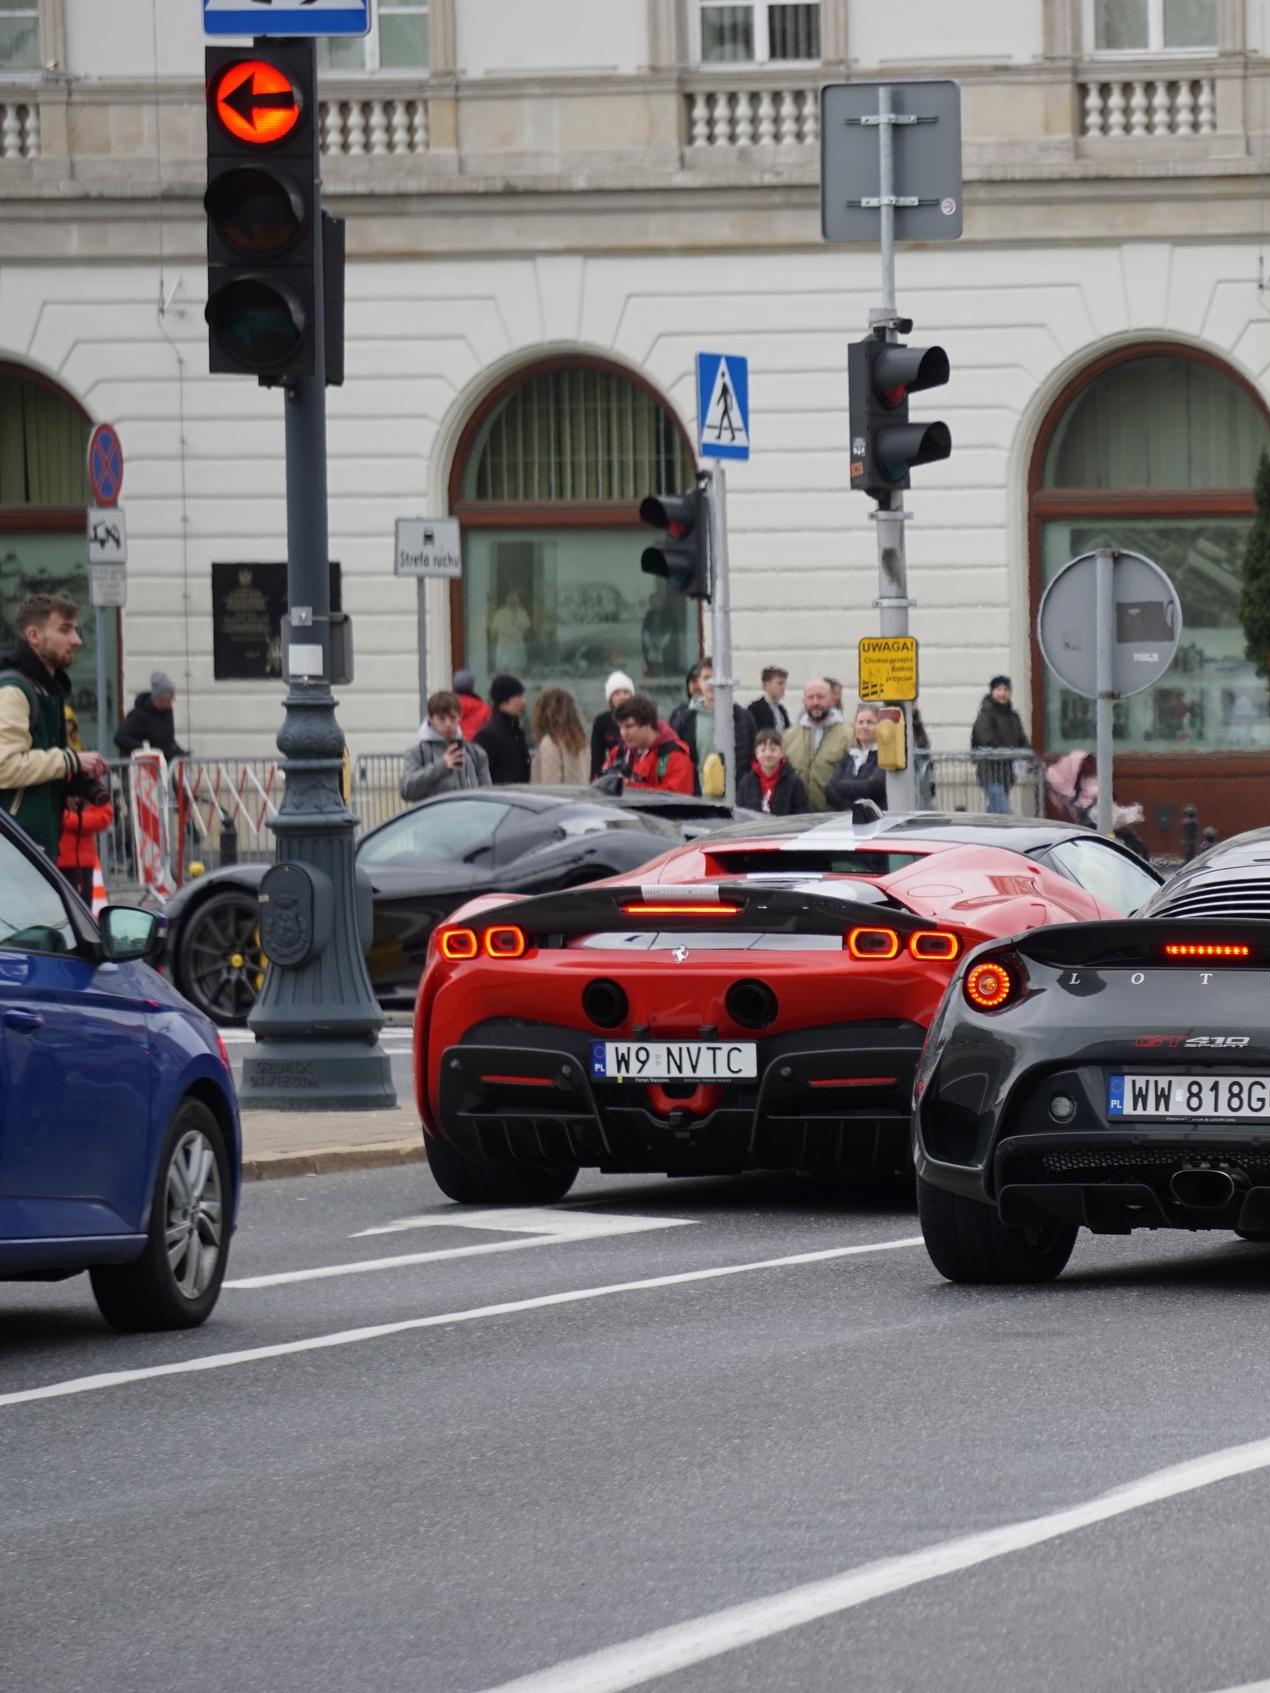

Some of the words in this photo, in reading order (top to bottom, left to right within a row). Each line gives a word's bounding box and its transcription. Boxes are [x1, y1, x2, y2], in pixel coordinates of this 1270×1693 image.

[400, 550, 430, 568] Strefa
[433, 550, 460, 568] ruchu
[862, 641, 914, 653] UWAGA!
[886, 675, 914, 683] przycisk
[1134, 1035, 1189, 1048] GT
[1185, 1036, 1251, 1045] 410
[594, 1063, 606, 1073] PL
[614, 1046, 650, 1074] W9
[666, 1046, 743, 1075] NVTC
[1110, 1100, 1122, 1109] PL
[1131, 1079, 1173, 1112] WW
